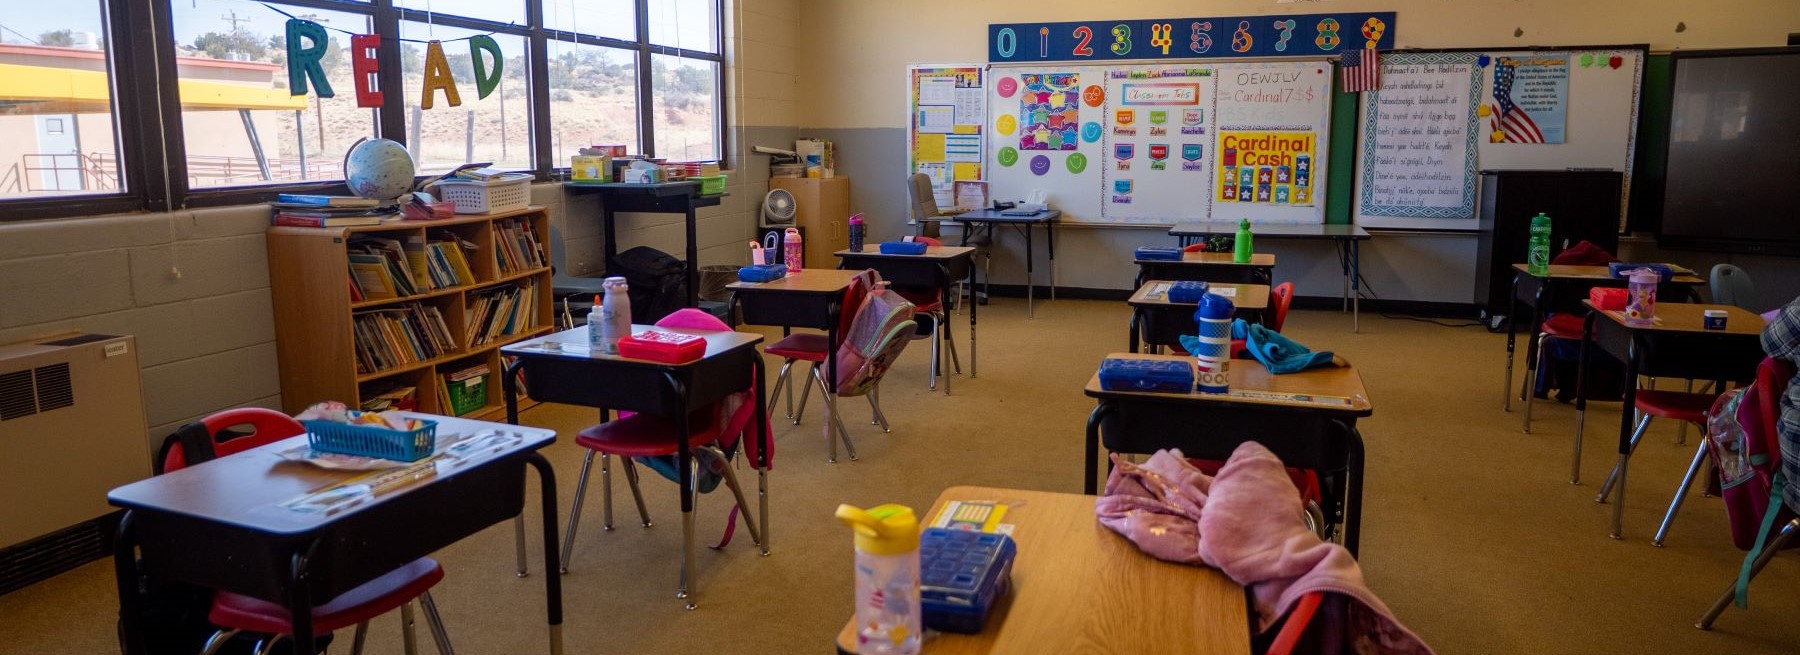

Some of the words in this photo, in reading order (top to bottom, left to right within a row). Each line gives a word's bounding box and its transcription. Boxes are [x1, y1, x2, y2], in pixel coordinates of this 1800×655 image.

[997, 27, 1017, 57] 0
[1040, 27, 1050, 57] 1
[1073, 26, 1093, 56] 2
[1111, 24, 1132, 55] 3
[1151, 23, 1172, 54] 4
[1190, 22, 1212, 53] 5
[1231, 20, 1253, 53] 6
[1274, 19, 1296, 51] 7
[1315, 17, 1340, 50] 8
[1361, 17, 1385, 49] 9
[286, 18, 503, 110] READ
[1237, 71, 1302, 86] OEWJLV
[1223, 135, 1310, 152] Cardinal
[1242, 151, 1292, 167] Cash
